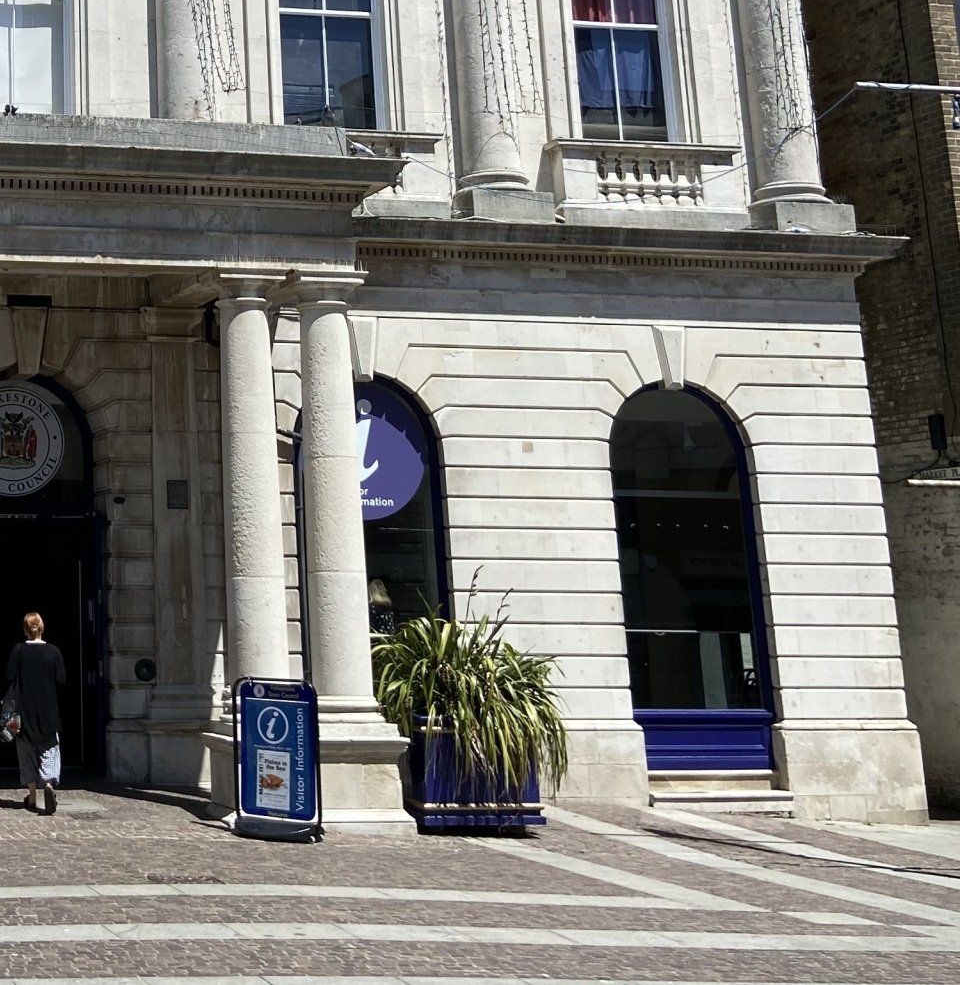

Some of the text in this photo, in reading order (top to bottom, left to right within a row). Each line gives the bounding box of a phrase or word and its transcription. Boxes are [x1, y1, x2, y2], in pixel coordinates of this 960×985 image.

[8, 456, 58, 492] COUNCIL
[360, 497, 394, 506] mation
[296, 707, 305, 812] Visitor Information
